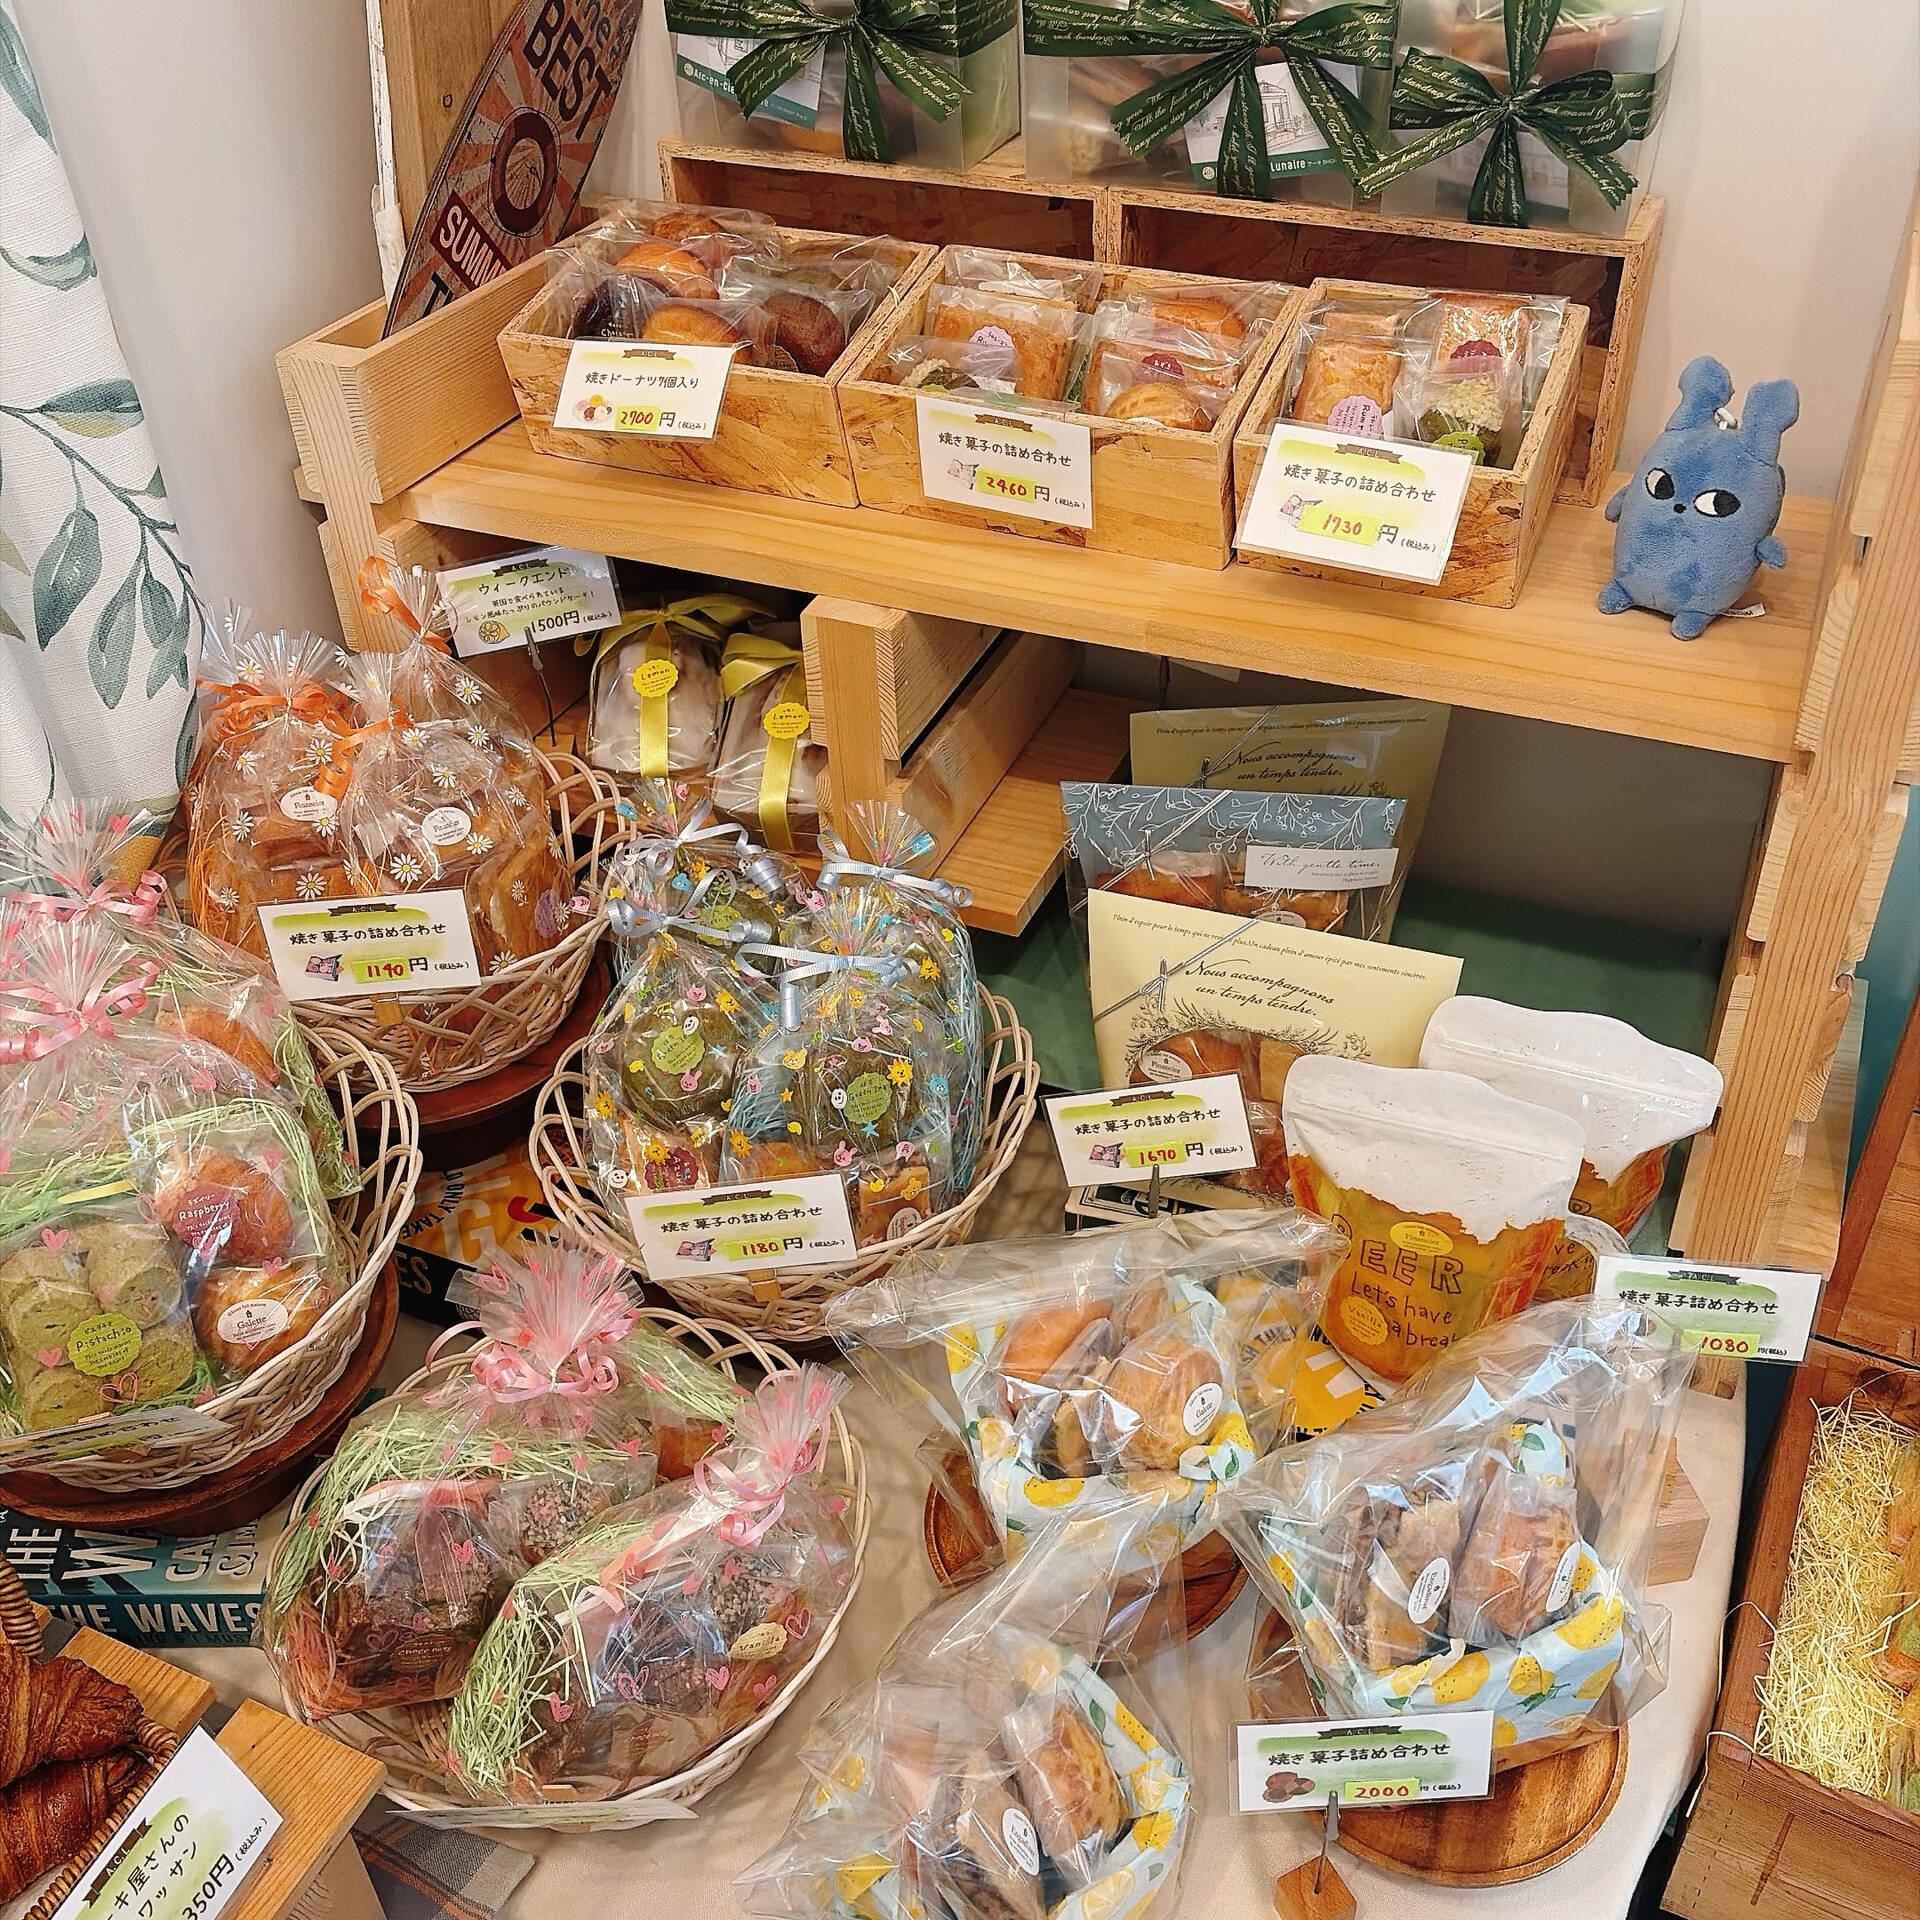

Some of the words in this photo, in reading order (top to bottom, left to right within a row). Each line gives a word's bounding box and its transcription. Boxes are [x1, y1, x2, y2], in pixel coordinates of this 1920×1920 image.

[523, 0, 612, 141] BEST
[1270, 159, 1306, 172] Lunaire
[439, 205, 506, 287] SUMM
[585, 371, 699, 389] 焼きドーナツ7個入り
[938, 432, 1072, 467] 焼き菓子の詰め合わせ
[1283, 463, 1437, 503] 焼き菓子の詰め合わせ
[478, 567, 570, 596] ウィークエンド
[1258, 768, 1296, 782] temps
[289, 923, 447, 946] 焼き菓子の詰め合わせ
[1185, 959, 1251, 978] Nous
[1230, 972, 1334, 1004] accompagnons
[1195, 985, 1217, 994] un
[1220, 986, 1263, 1007] temps
[1267, 995, 1317, 1016] tendre.
[1074, 1107, 1222, 1135] 焼き菓子の詰め合わせ
[179, 1200, 230, 1222] Raspberry
[438, 1183, 465, 1214] ONLY
[660, 1206, 823, 1233] 焼き菓子の詰め合わせ
[1554, 1242, 1576, 1255] ve
[1351, 1271, 1397, 1308] Let's
[1404, 1295, 1453, 1324] have
[1619, 1290, 1779, 1315] 焼き菓子詰め合わせ
[61, 1529, 158, 1580] W
[1268, 1743, 1451, 1766] 焼き菓子詰め合わせ
[1354, 1786, 1409, 1799] 2000
